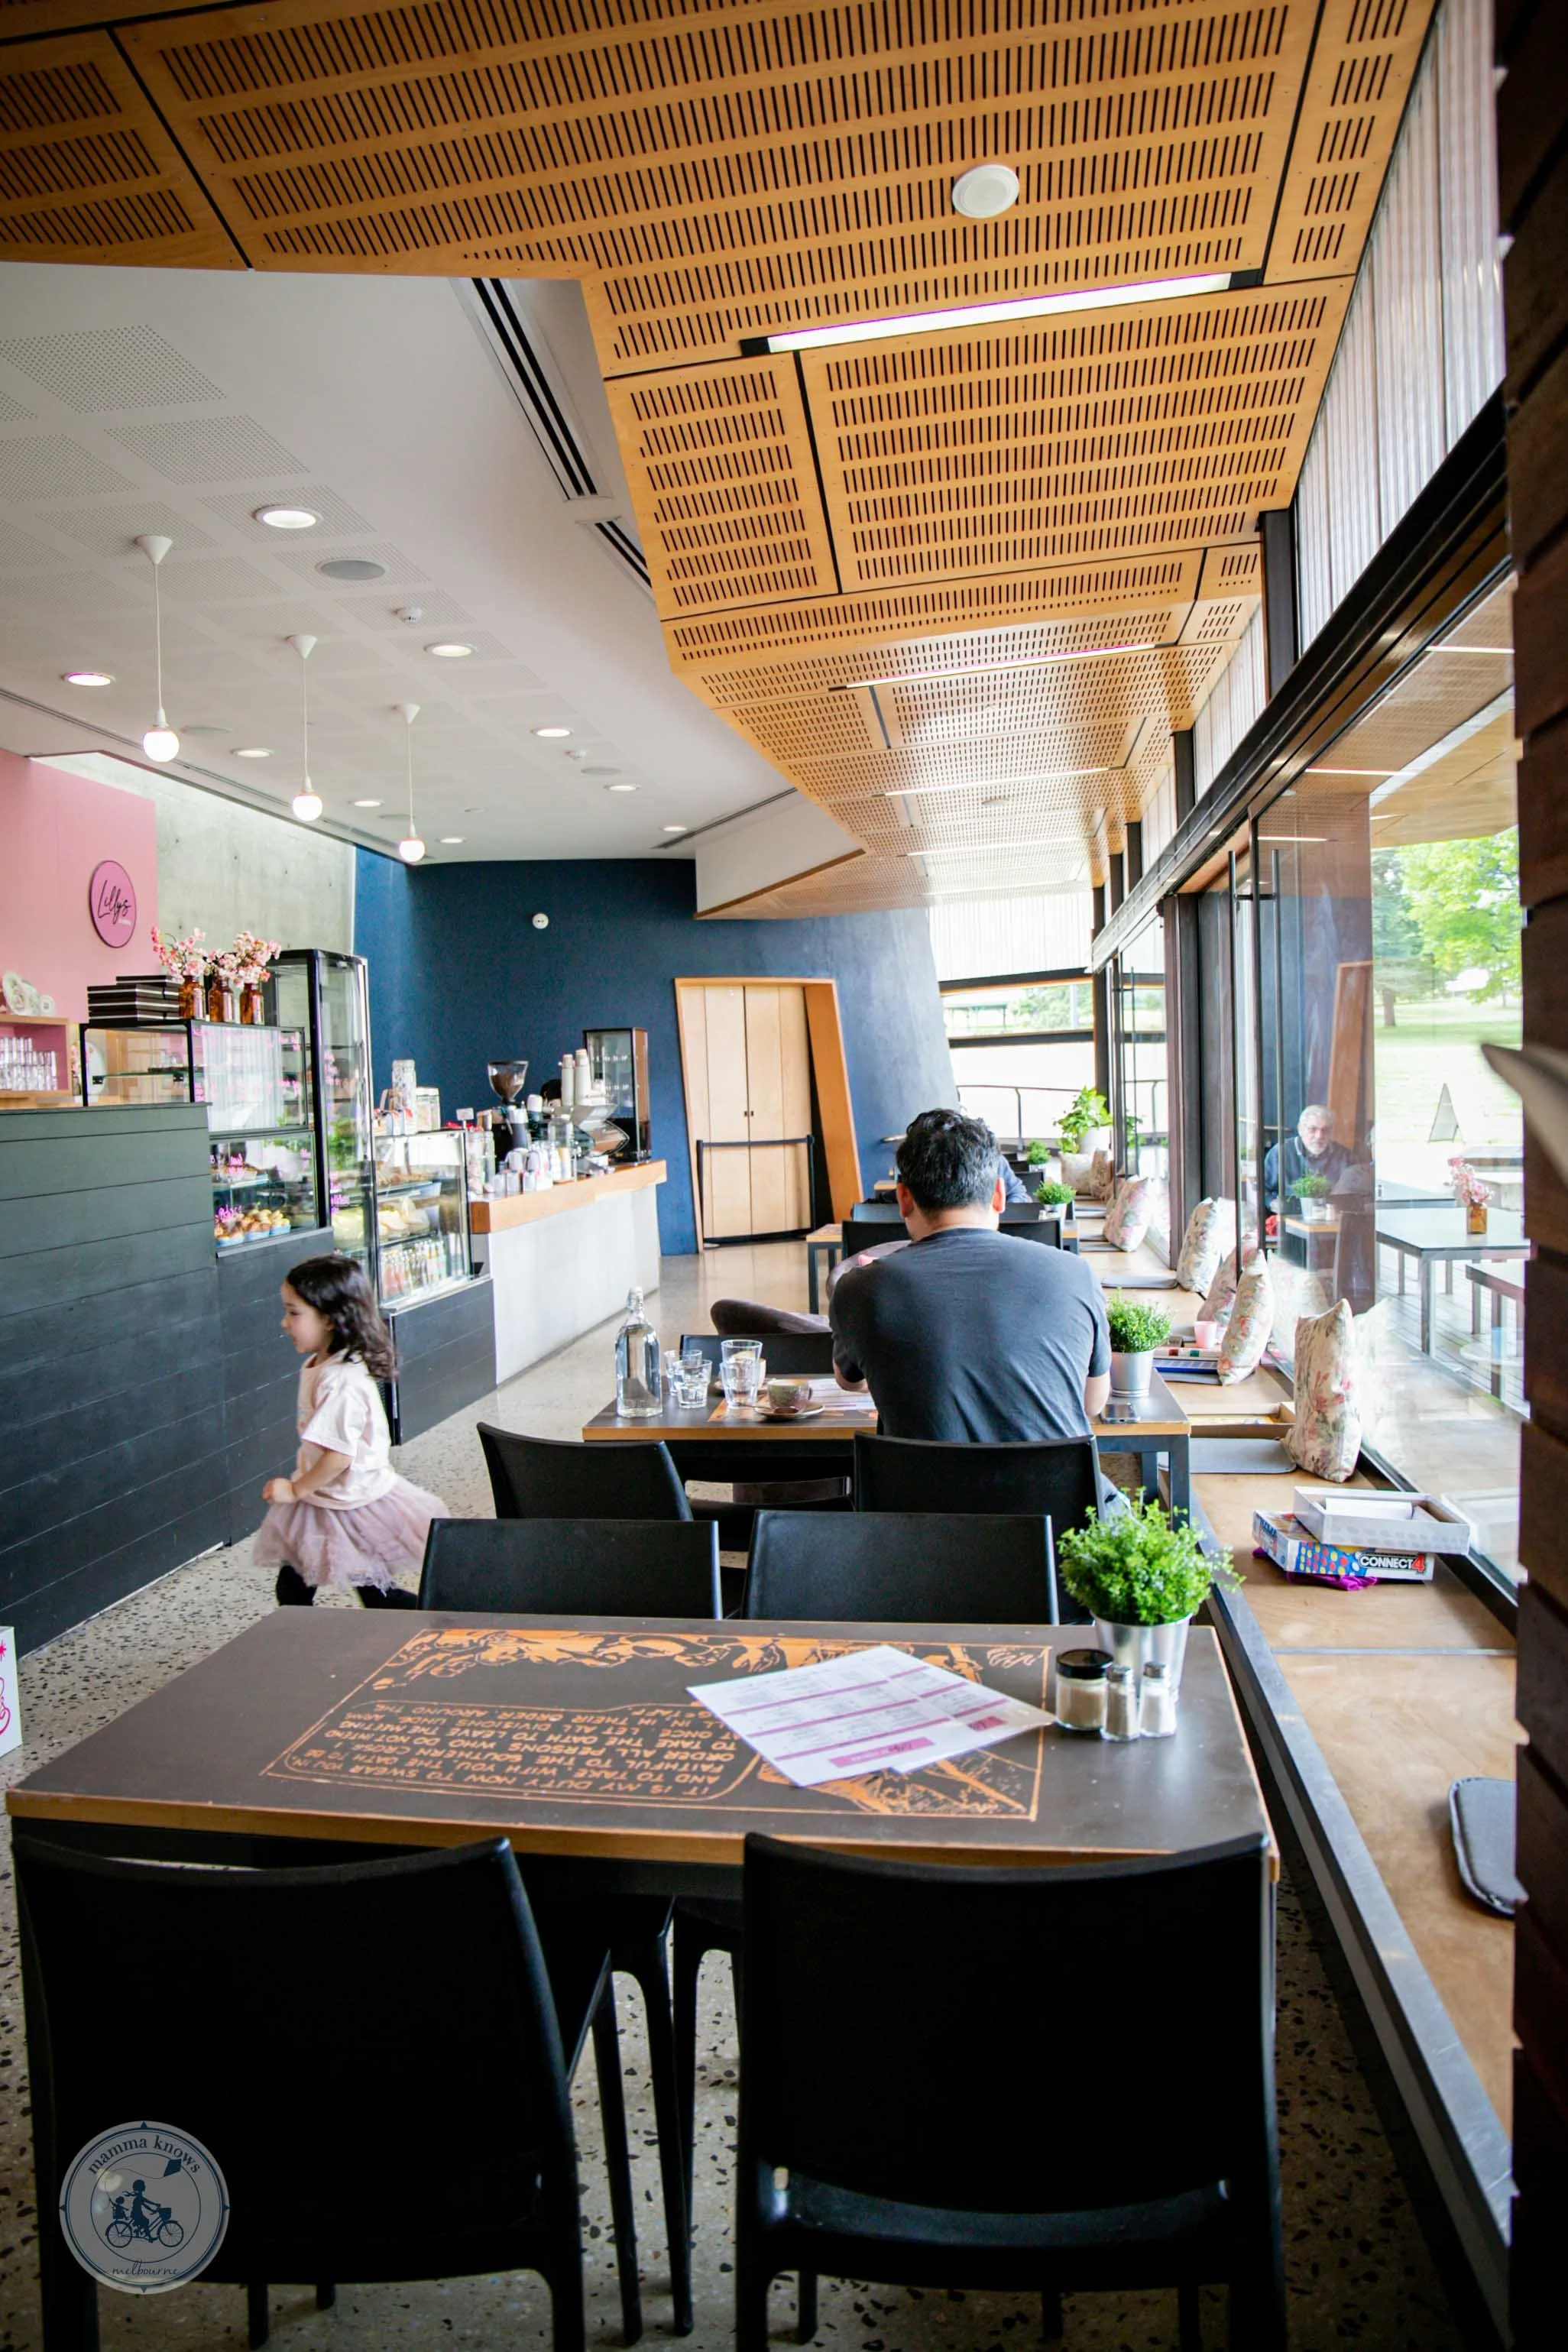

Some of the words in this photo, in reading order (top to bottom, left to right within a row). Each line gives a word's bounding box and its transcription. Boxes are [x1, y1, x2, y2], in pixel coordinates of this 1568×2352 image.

[1359, 1554, 1413, 1570] CONNECT
[1412, 1553, 1426, 1573] 4
[374, 1705, 404, 1713] THE
[412, 1706, 489, 1717] AROUND
[572, 1715, 629, 1725] THEIR
[407, 1725, 439, 1736] THE
[455, 1719, 552, 1732] DIVISIONS
[563, 1724, 597, 1733] ALL
[601, 1726, 640, 1735] LET
[446, 1727, 507, 1738] LEAVE
[512, 1732, 538, 1741] TO
[374, 1735, 410, 1744] NOT
[412, 1737, 440, 1746] DO
[448, 1739, 497, 1749] WHO
[546, 1734, 598, 1745] OATH
[605, 1736, 643, 1747] THE
[655, 1739, 701, 1750] TAKE
[507, 1742, 606, 1756] PERSONS
[711, 1741, 737, 1751] TO
[415, 1748, 523, 1763] SOUTHERN
[615, 1748, 657, 1758] ALL
[664, 1750, 735, 1761] ORDER
[354, 1753, 400, 1764] OATH
[404, 1758, 443, 1768] THE
[536, 1756, 576, 1766] THE
[585, 1758, 612, 1768] TO
[313, 1760, 343, 1770] YOU
[625, 1759, 724, 1773] FAITHFUL
[349, 1765, 419, 1778] SWEAR
[426, 1771, 453, 1780] TO
[505, 1765, 557, 1776] WITH
[464, 1774, 517, 1784] NOW
[637, 1771, 664, 1782] TO
[675, 1773, 721, 1784] AND
[524, 1778, 593, 1790] DUTY
[598, 1783, 642, 1792] MY
[651, 1784, 672, 1793] IS
[683, 1786, 709, 1795] IT
